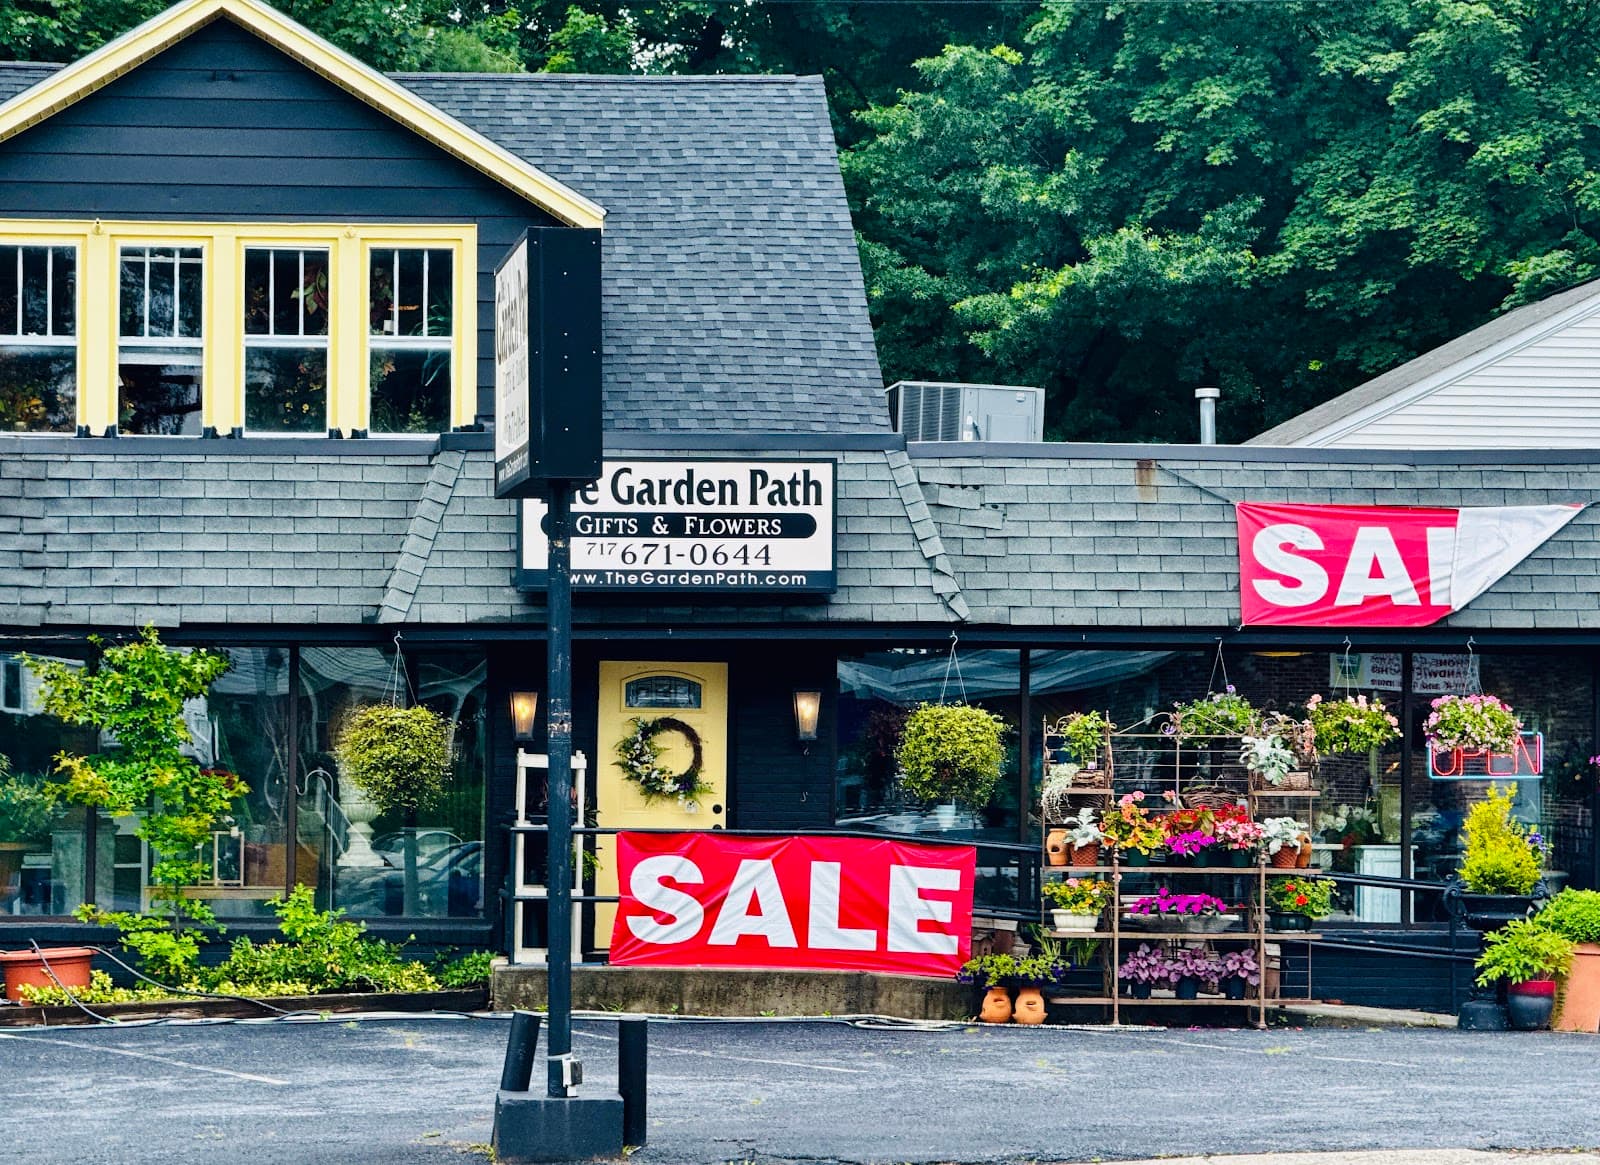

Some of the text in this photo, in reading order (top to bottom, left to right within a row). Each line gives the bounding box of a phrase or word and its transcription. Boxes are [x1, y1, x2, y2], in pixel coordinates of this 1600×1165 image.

[610, 467, 738, 506] Garden
[749, 468, 823, 506] Path
[575, 514, 782, 535] GIFTS & FLOWERS
[586, 542, 771, 566] 717 671-0644
[570, 571, 807, 586] ww.TheGardenPath.com
[626, 855, 961, 955] SALE
